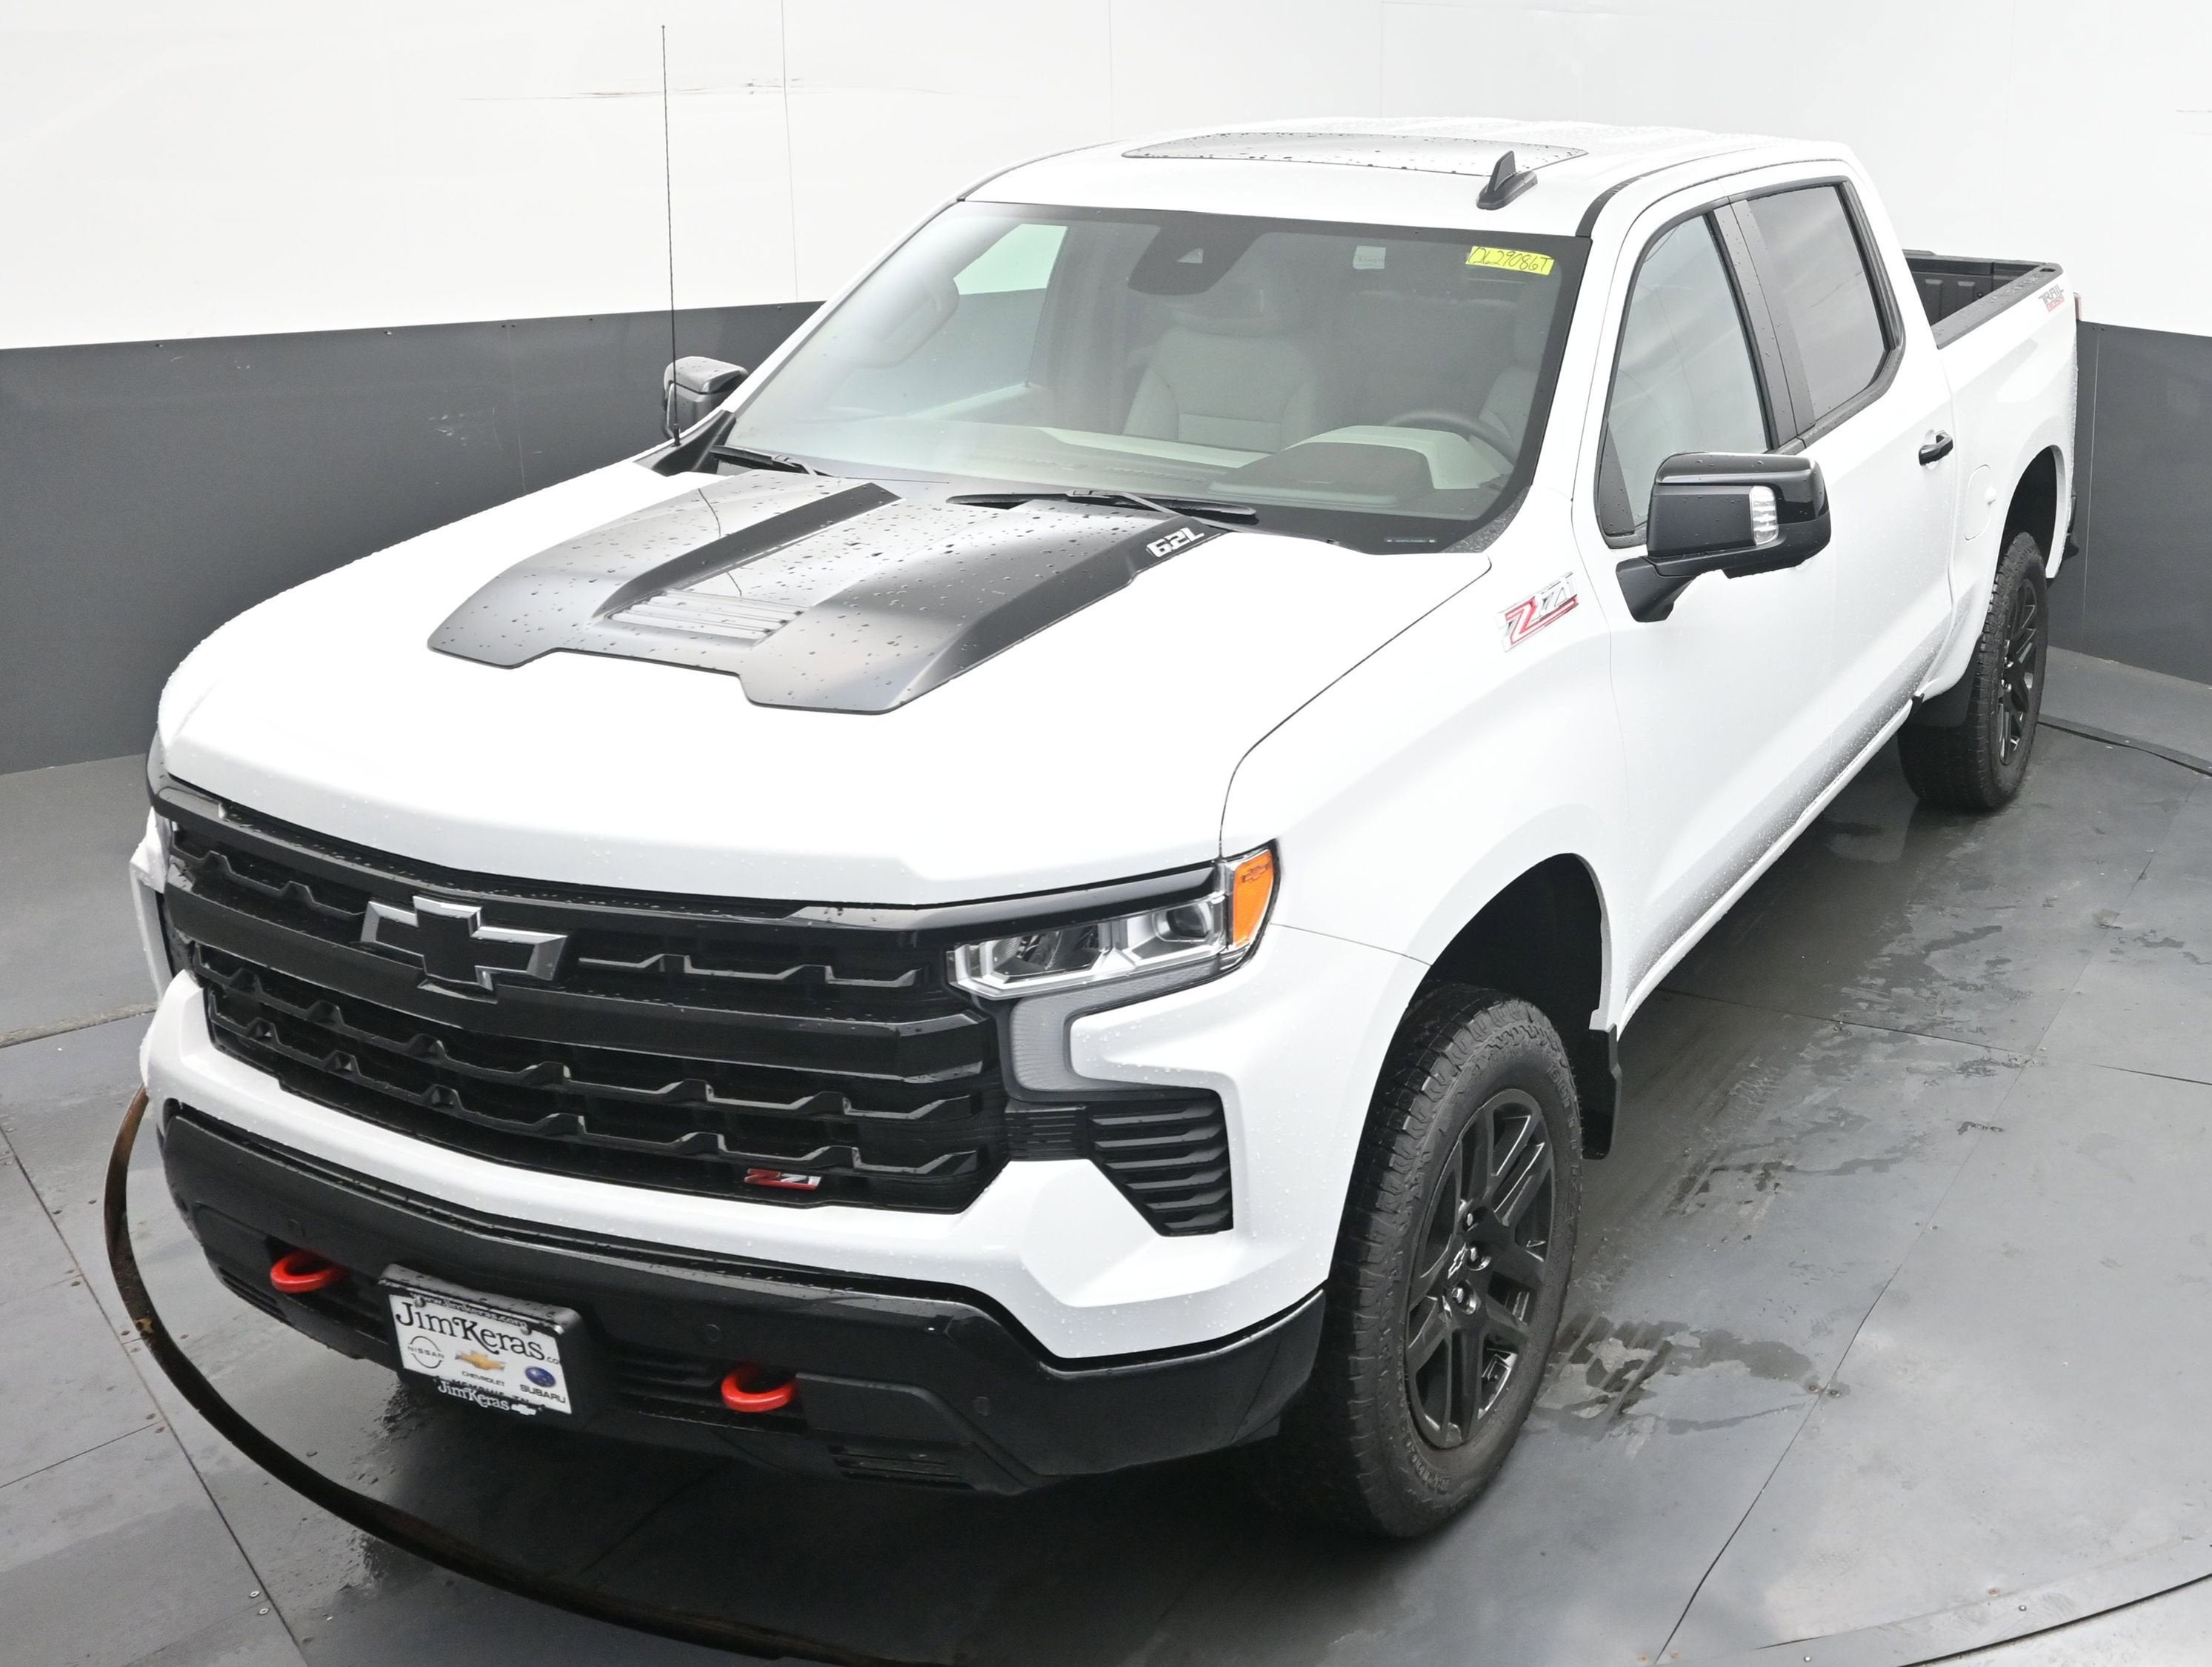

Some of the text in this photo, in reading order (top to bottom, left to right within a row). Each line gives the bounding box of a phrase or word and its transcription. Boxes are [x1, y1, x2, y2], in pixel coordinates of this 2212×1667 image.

[2038, 284, 2065, 305] TRAIL
[1496, 572, 1579, 652] Z71
[744, 1168, 822, 1191] Z71
[407, 1345, 444, 1360] NISSAN
[462, 1371, 505, 1387] CHEVROLET
[438, 1380, 510, 1411] JimKeras
[520, 1384, 566, 1403] SUBARU
